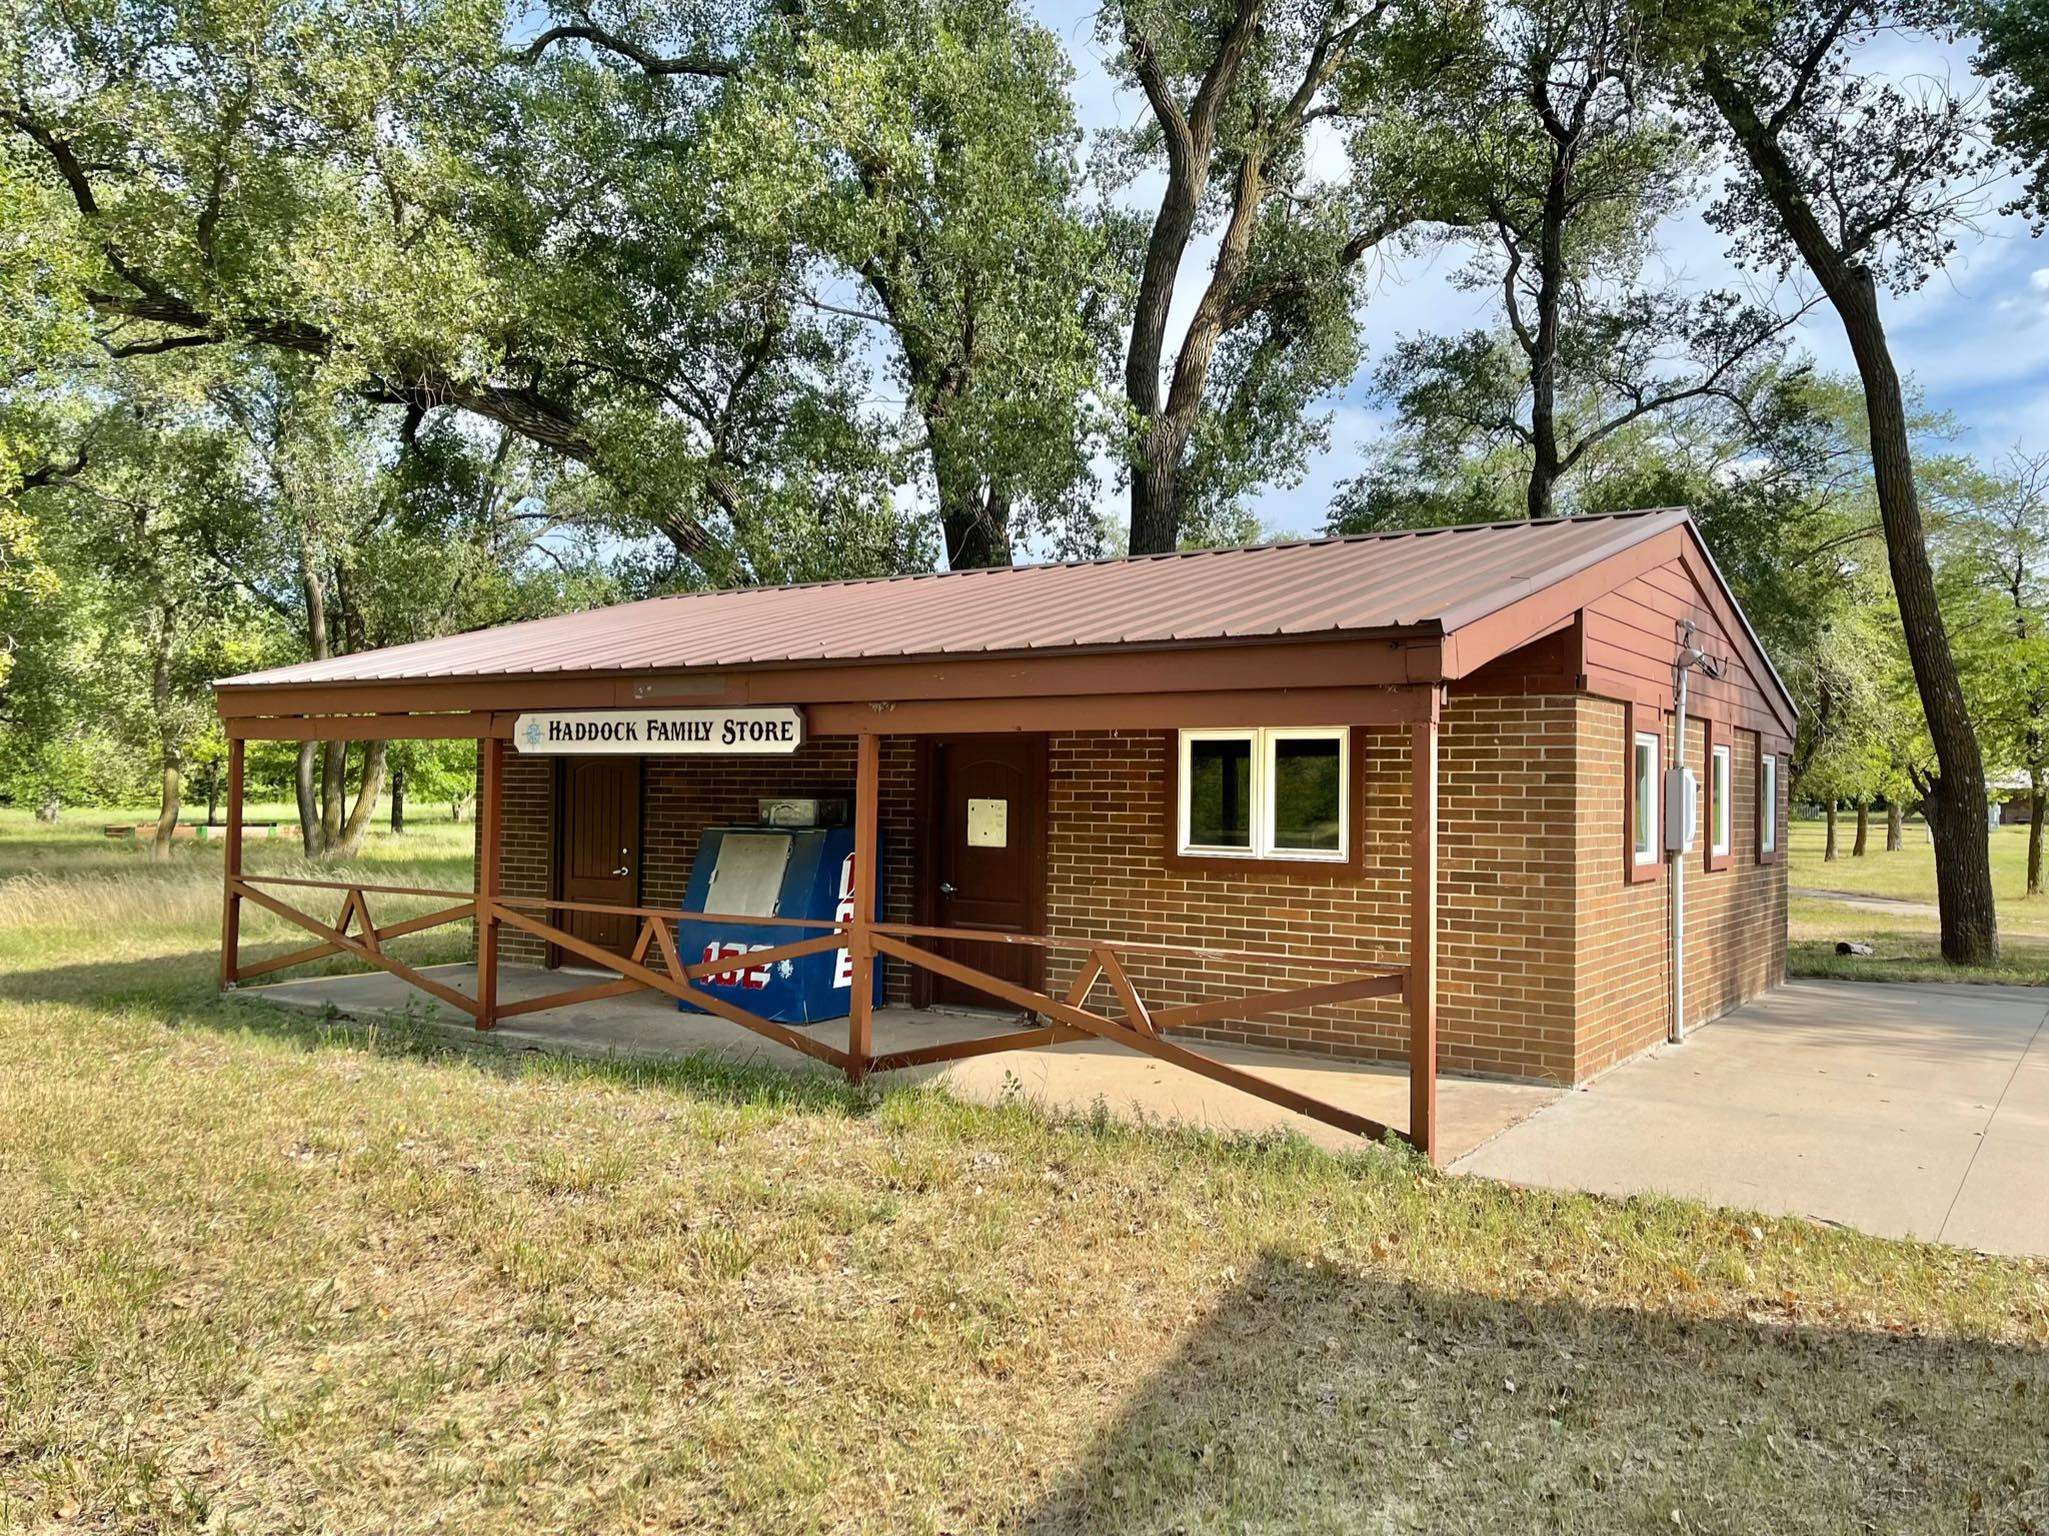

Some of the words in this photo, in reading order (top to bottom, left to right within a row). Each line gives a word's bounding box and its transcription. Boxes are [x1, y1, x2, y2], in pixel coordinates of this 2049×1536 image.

[548, 720, 639, 741] HADDOCK
[646, 719, 714, 741] FAMILY
[721, 719, 794, 745] STORE
